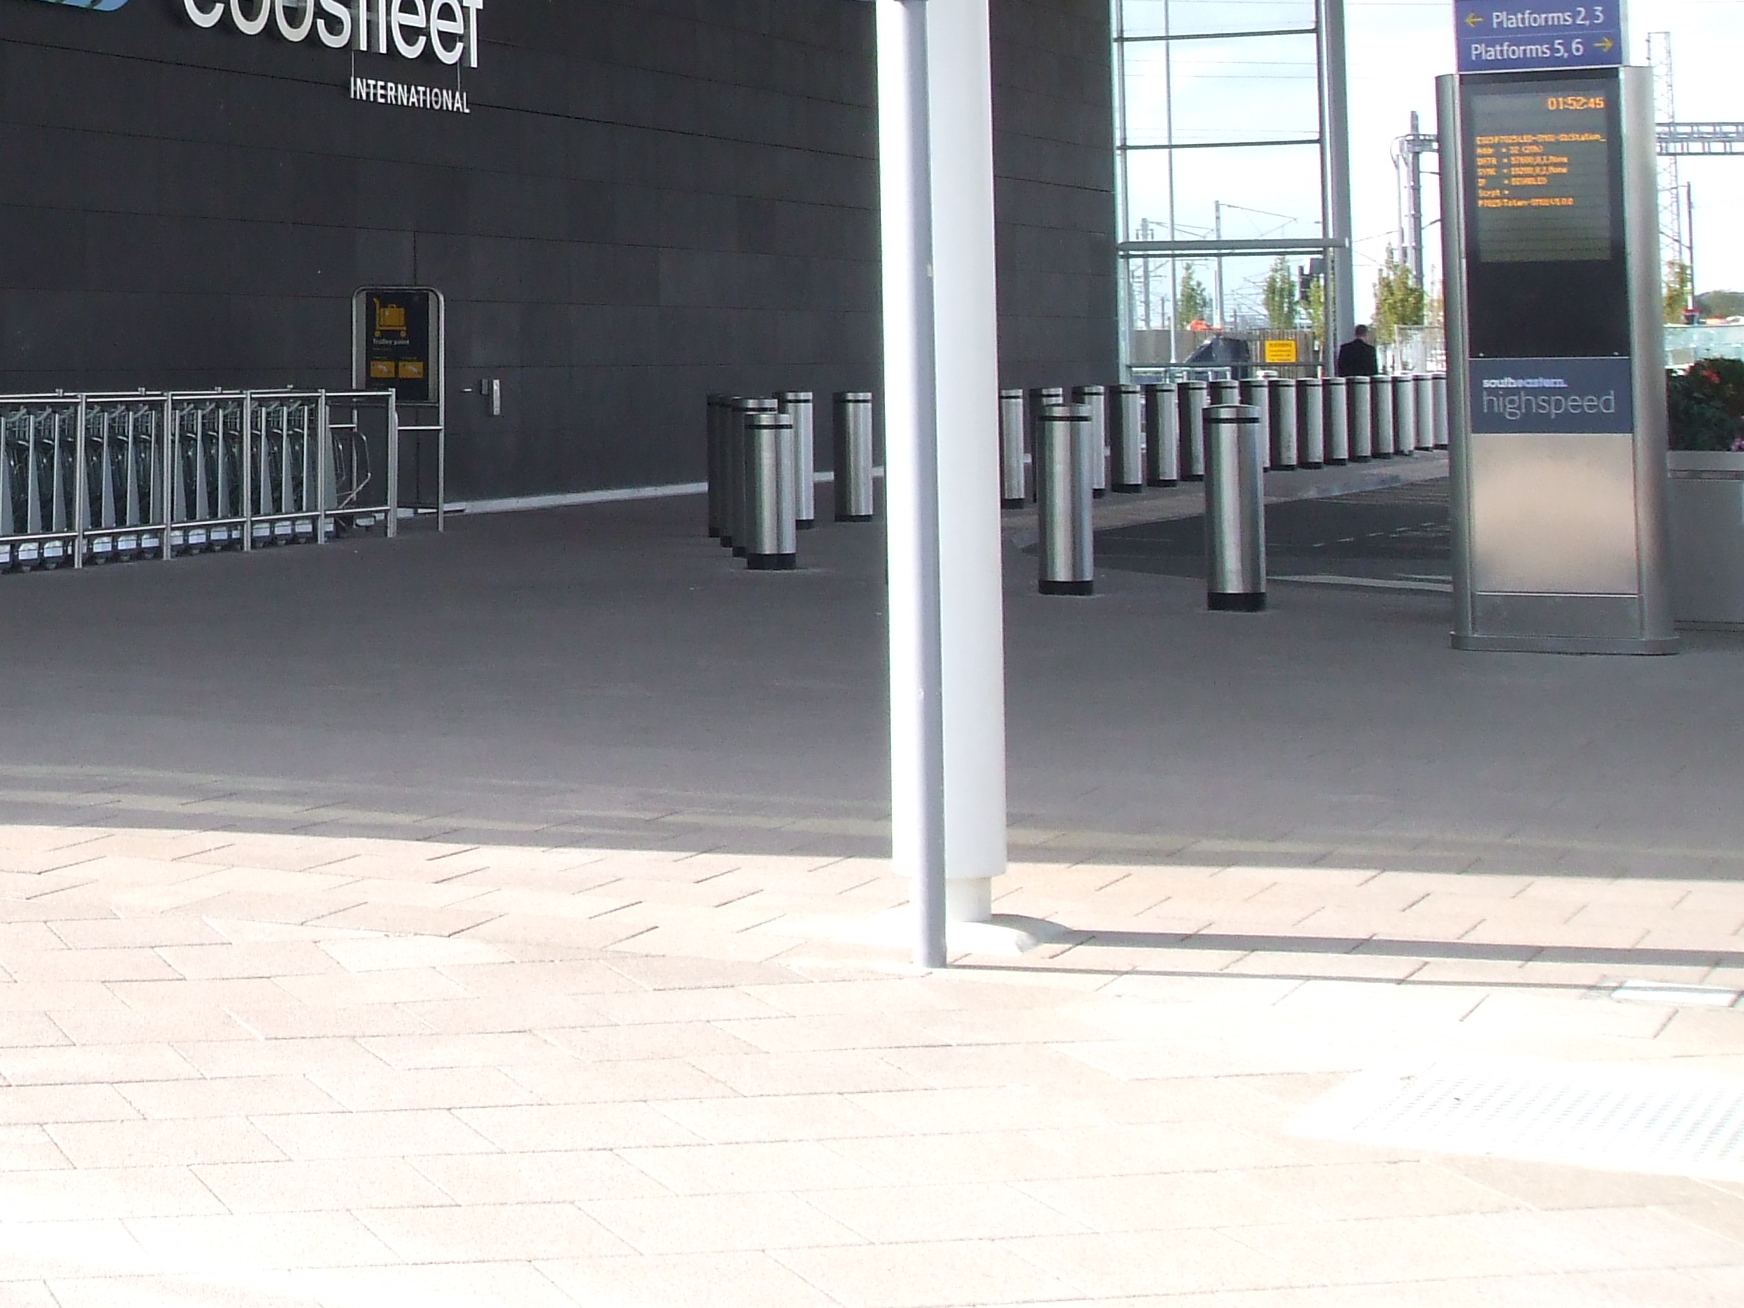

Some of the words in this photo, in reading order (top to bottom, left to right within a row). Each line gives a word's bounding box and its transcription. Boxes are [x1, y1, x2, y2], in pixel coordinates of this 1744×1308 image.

[1492, 9, 1572, 29] Platforms
[1576, 7, 1589, 26] 2,
[1593, 6, 1604, 24] 3
[1471, 41, 1550, 61] Platforms
[1554, 39, 1569, 58] 5,
[1571, 38, 1584, 56] 6
[350, 76, 471, 114] INTERNATIONAL
[1547, 96, 1605, 110] 01:52:45
[1483, 390, 1615, 420] highspeed
